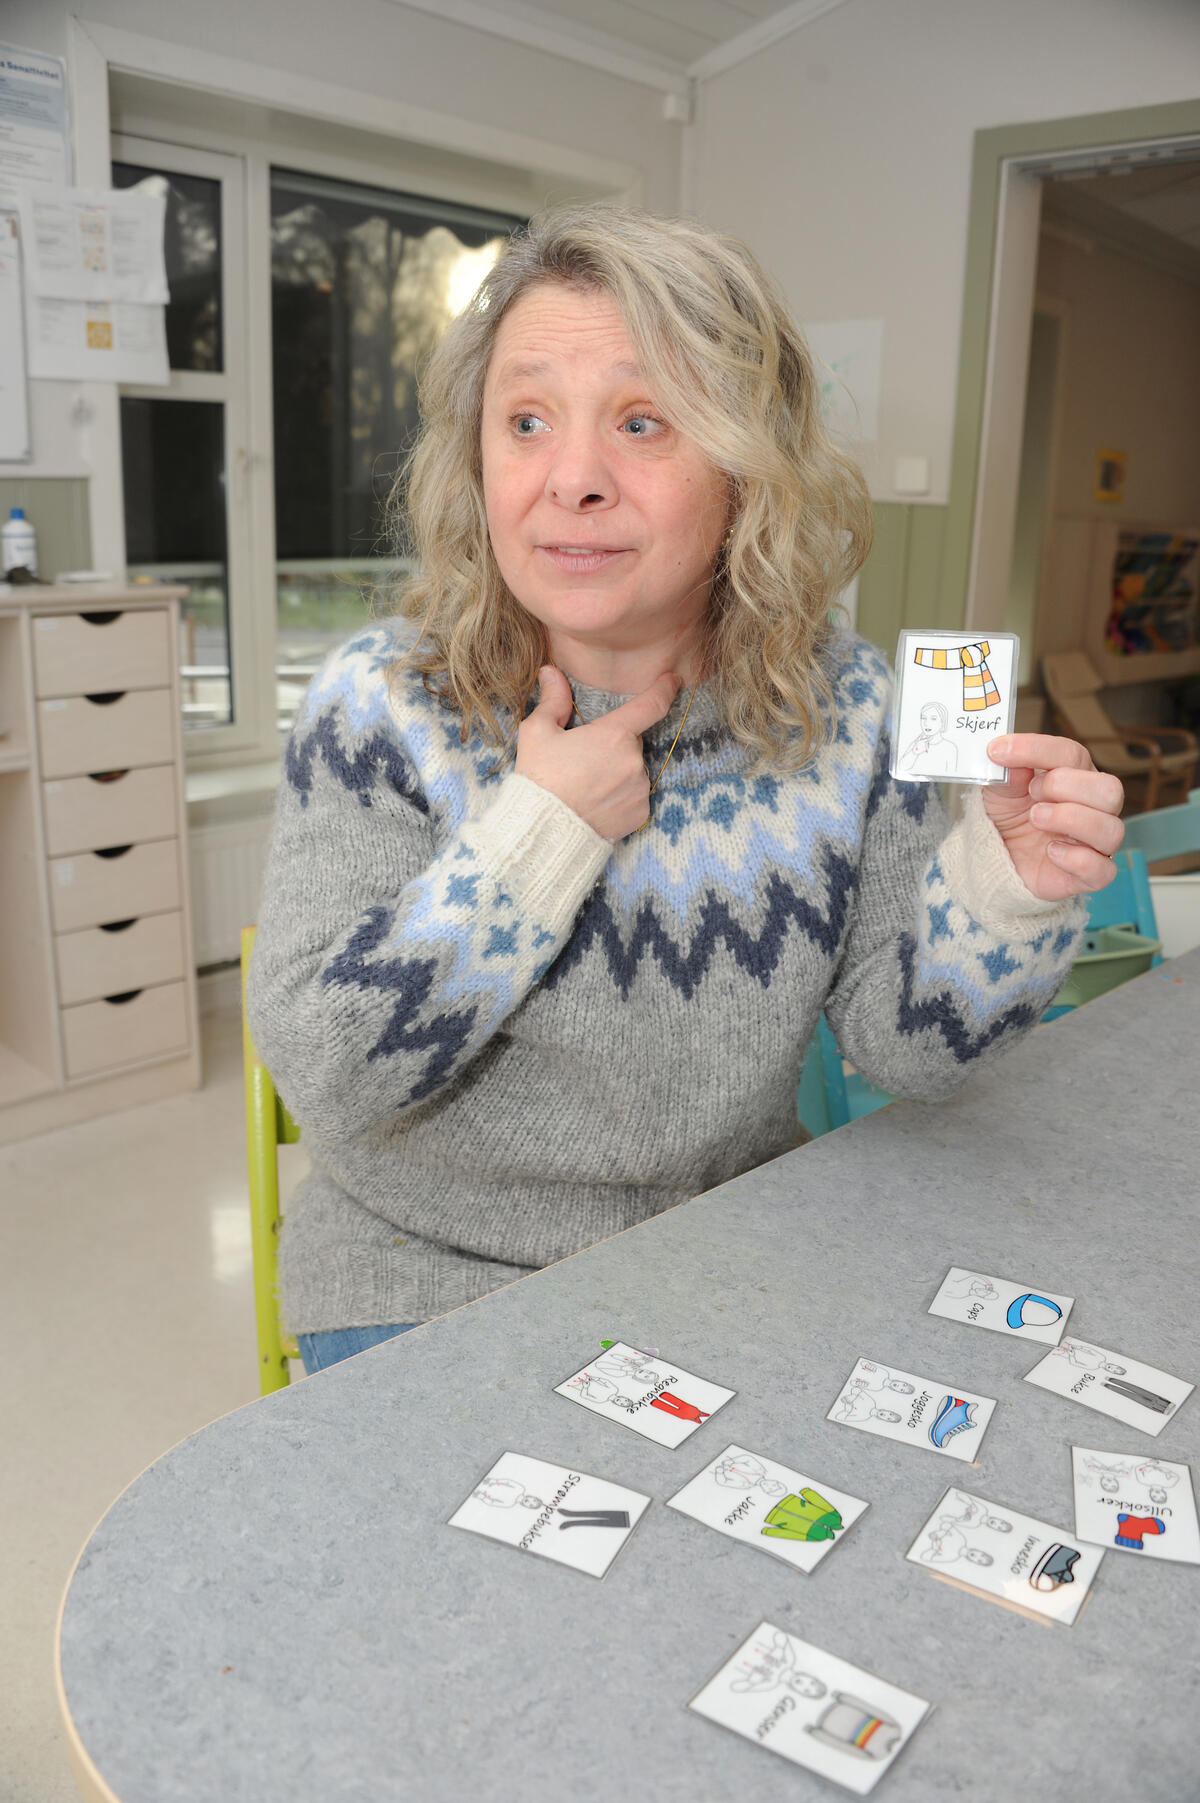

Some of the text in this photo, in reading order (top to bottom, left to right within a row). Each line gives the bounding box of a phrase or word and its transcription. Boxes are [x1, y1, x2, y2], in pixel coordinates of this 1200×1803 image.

[956, 716, 1001, 733] Skjerf
[967, 1303, 984, 1321] Caps
[626, 1375, 679, 1415] Regnbukse
[1071, 1373, 1095, 1394] Bukse
[907, 1390, 933, 1428] Joggesko
[519, 1473, 581, 1549] Strømpebukse
[724, 1496, 756, 1526] Jakke
[1096, 1497, 1173, 1517] Ullsokker
[1010, 1535, 1041, 1575] Innesko
[756, 1694, 797, 1740] Genser
